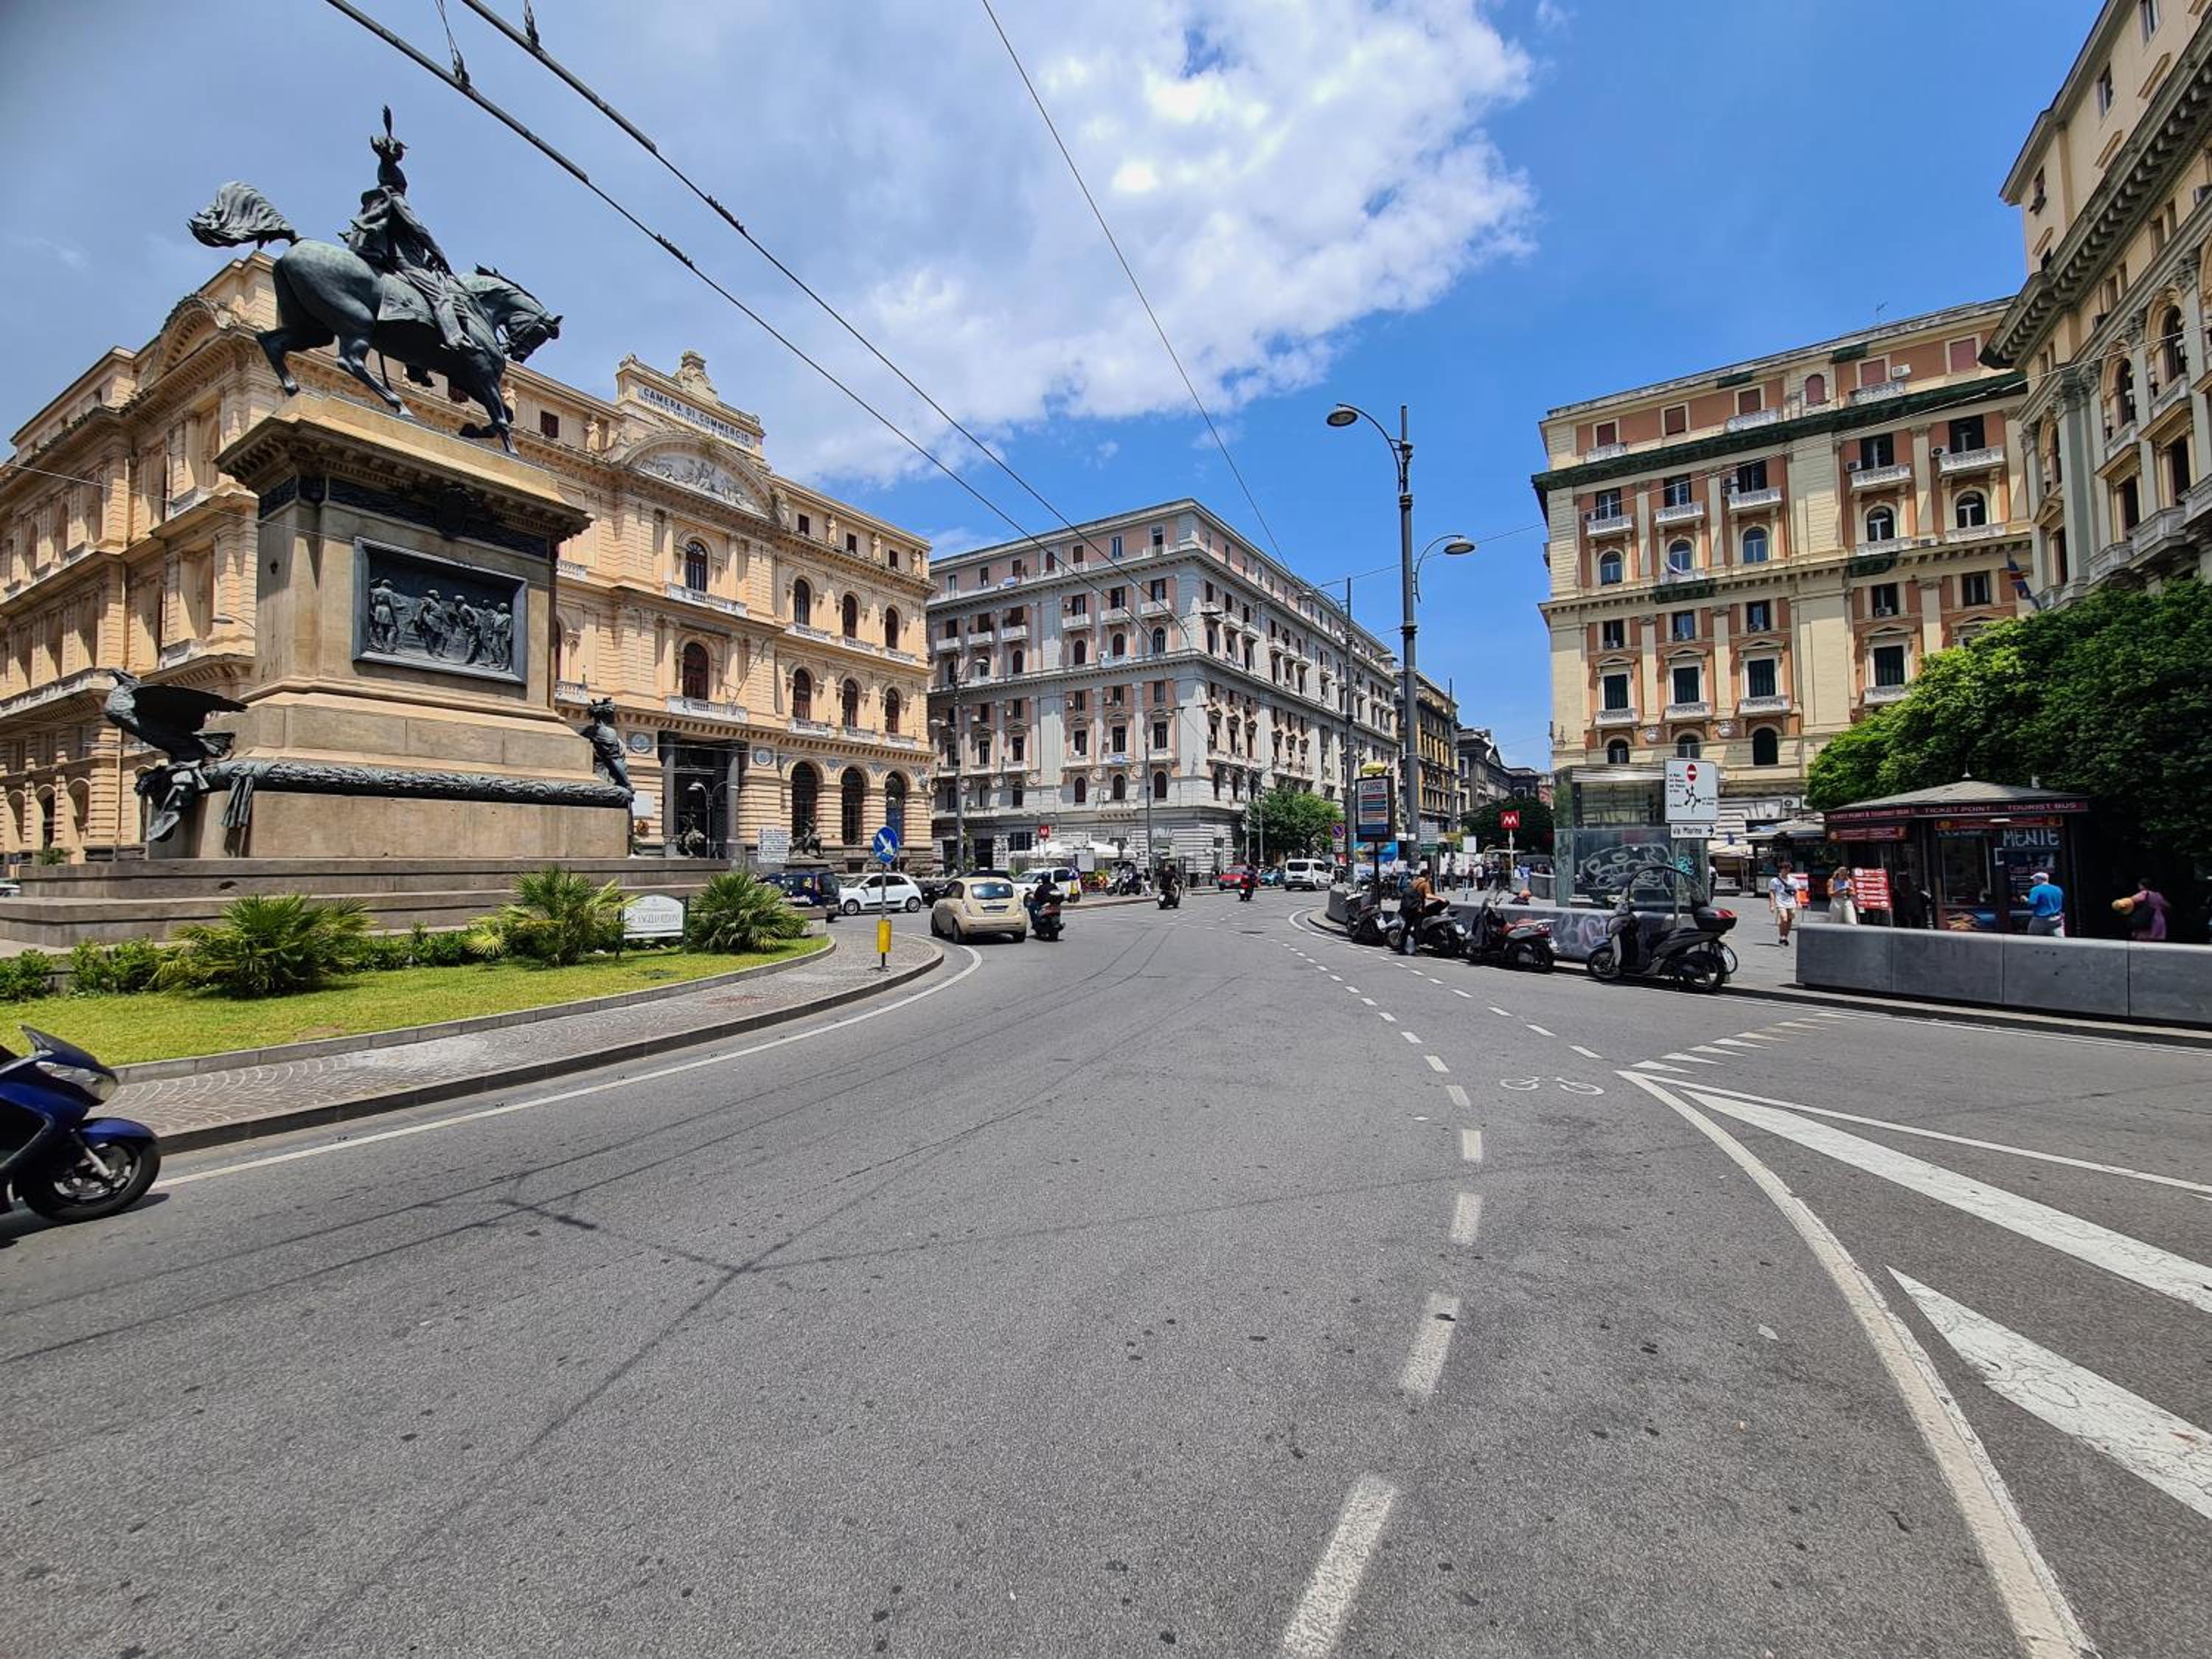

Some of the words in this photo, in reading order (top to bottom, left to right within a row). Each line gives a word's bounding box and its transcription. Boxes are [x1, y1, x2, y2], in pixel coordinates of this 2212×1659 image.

[644, 387, 682, 411] CAMERA
[686, 407, 696, 418] DI
[700, 414, 750, 442] COMMERCIO
[2007, 804, 2051, 812] TOURIST
